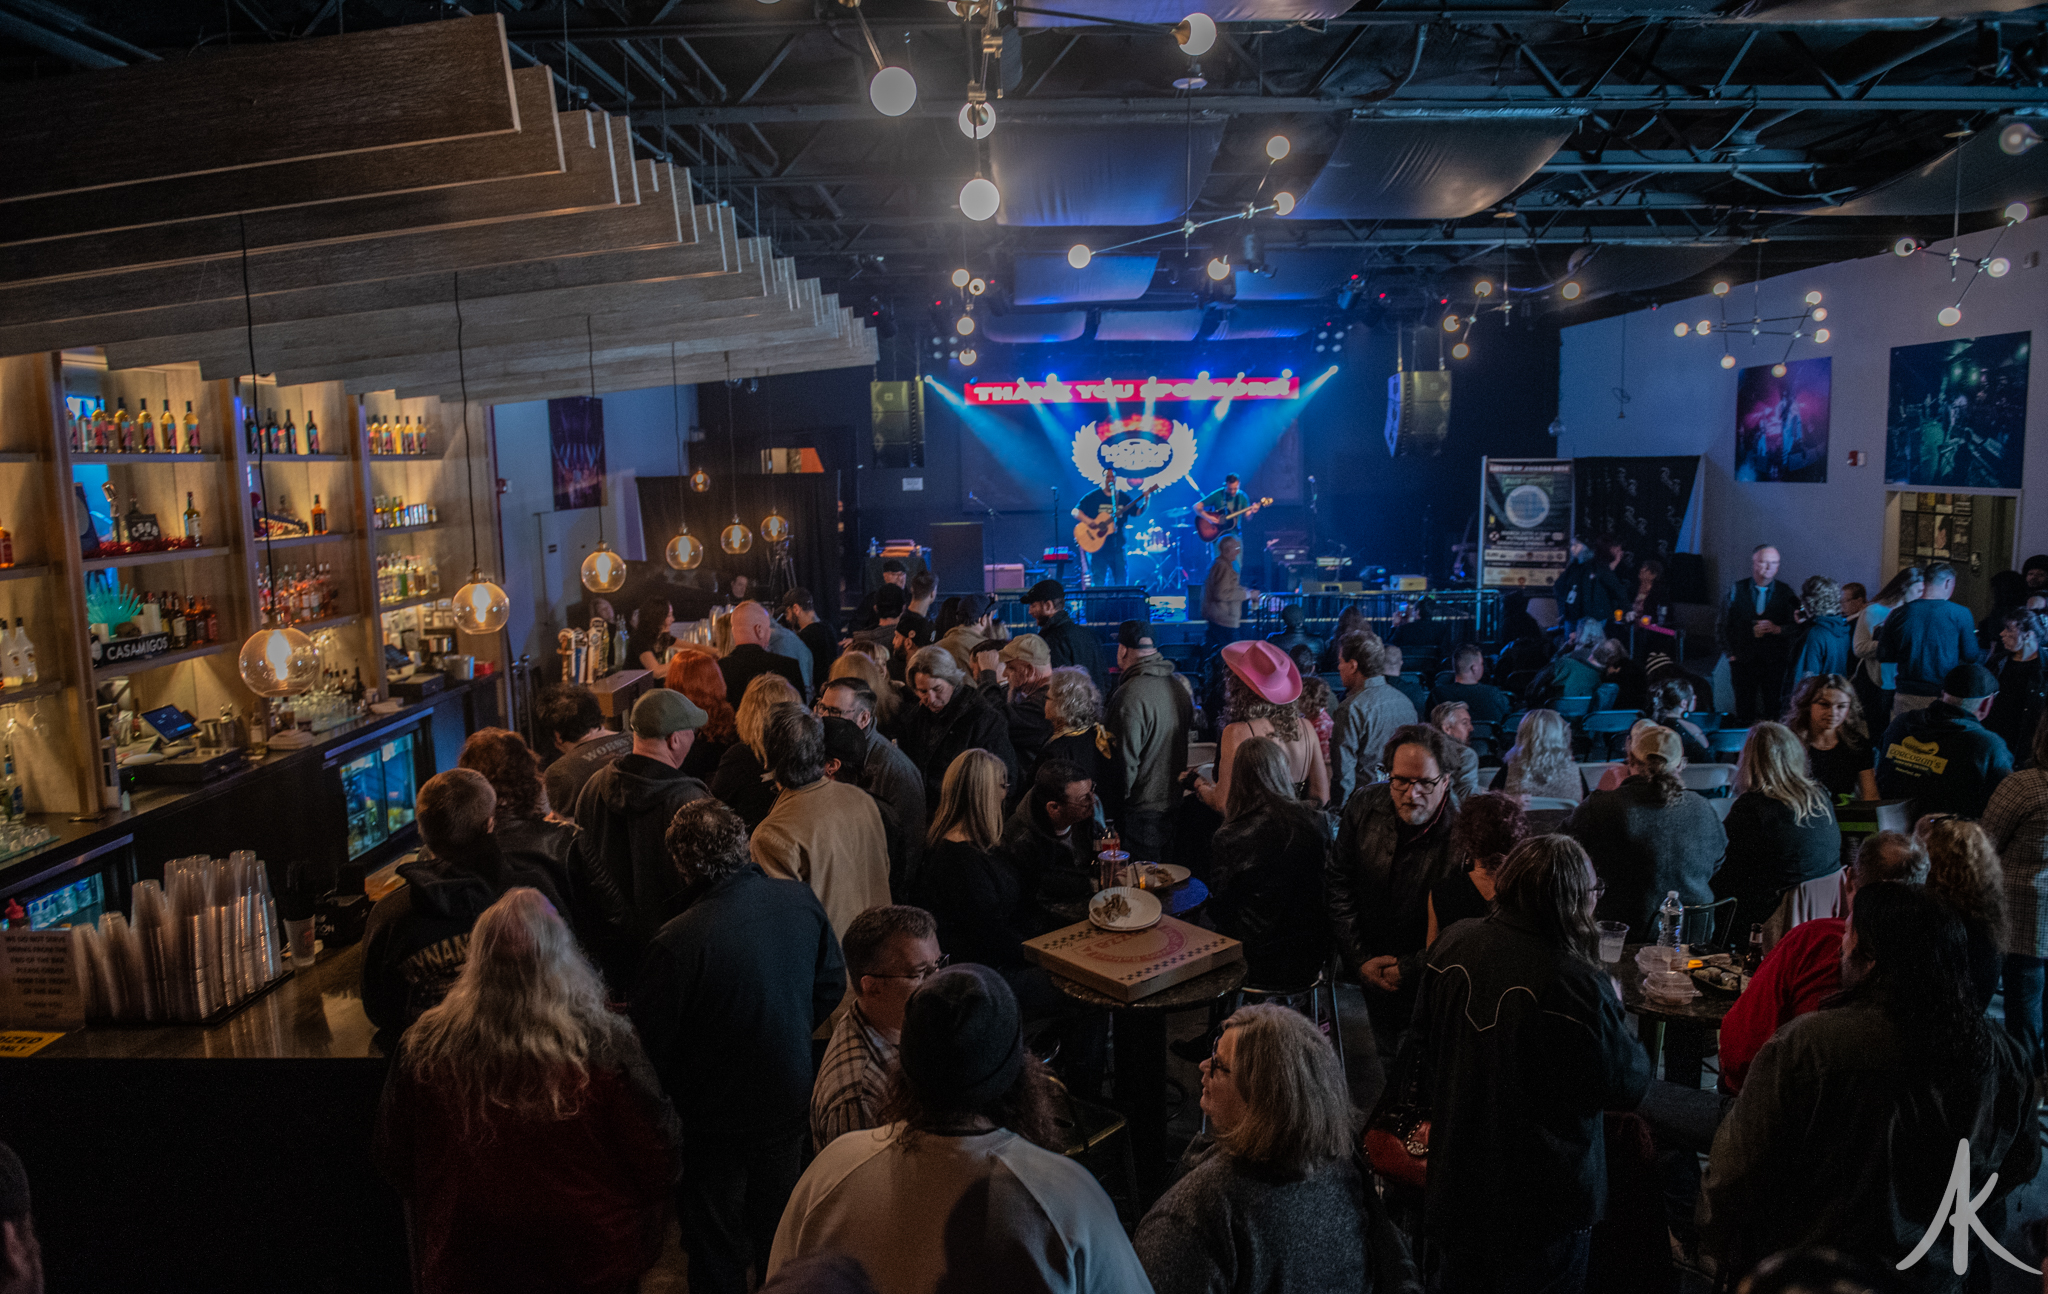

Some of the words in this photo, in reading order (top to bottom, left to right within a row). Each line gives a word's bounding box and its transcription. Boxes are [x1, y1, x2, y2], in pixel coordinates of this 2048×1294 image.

[974, 385, 1073, 402] THANK
[1076, 384, 1135, 399] YOU
[1140, 381, 1291, 398] SPOSORS!
[107, 636, 168, 661] CASAMIGOS
